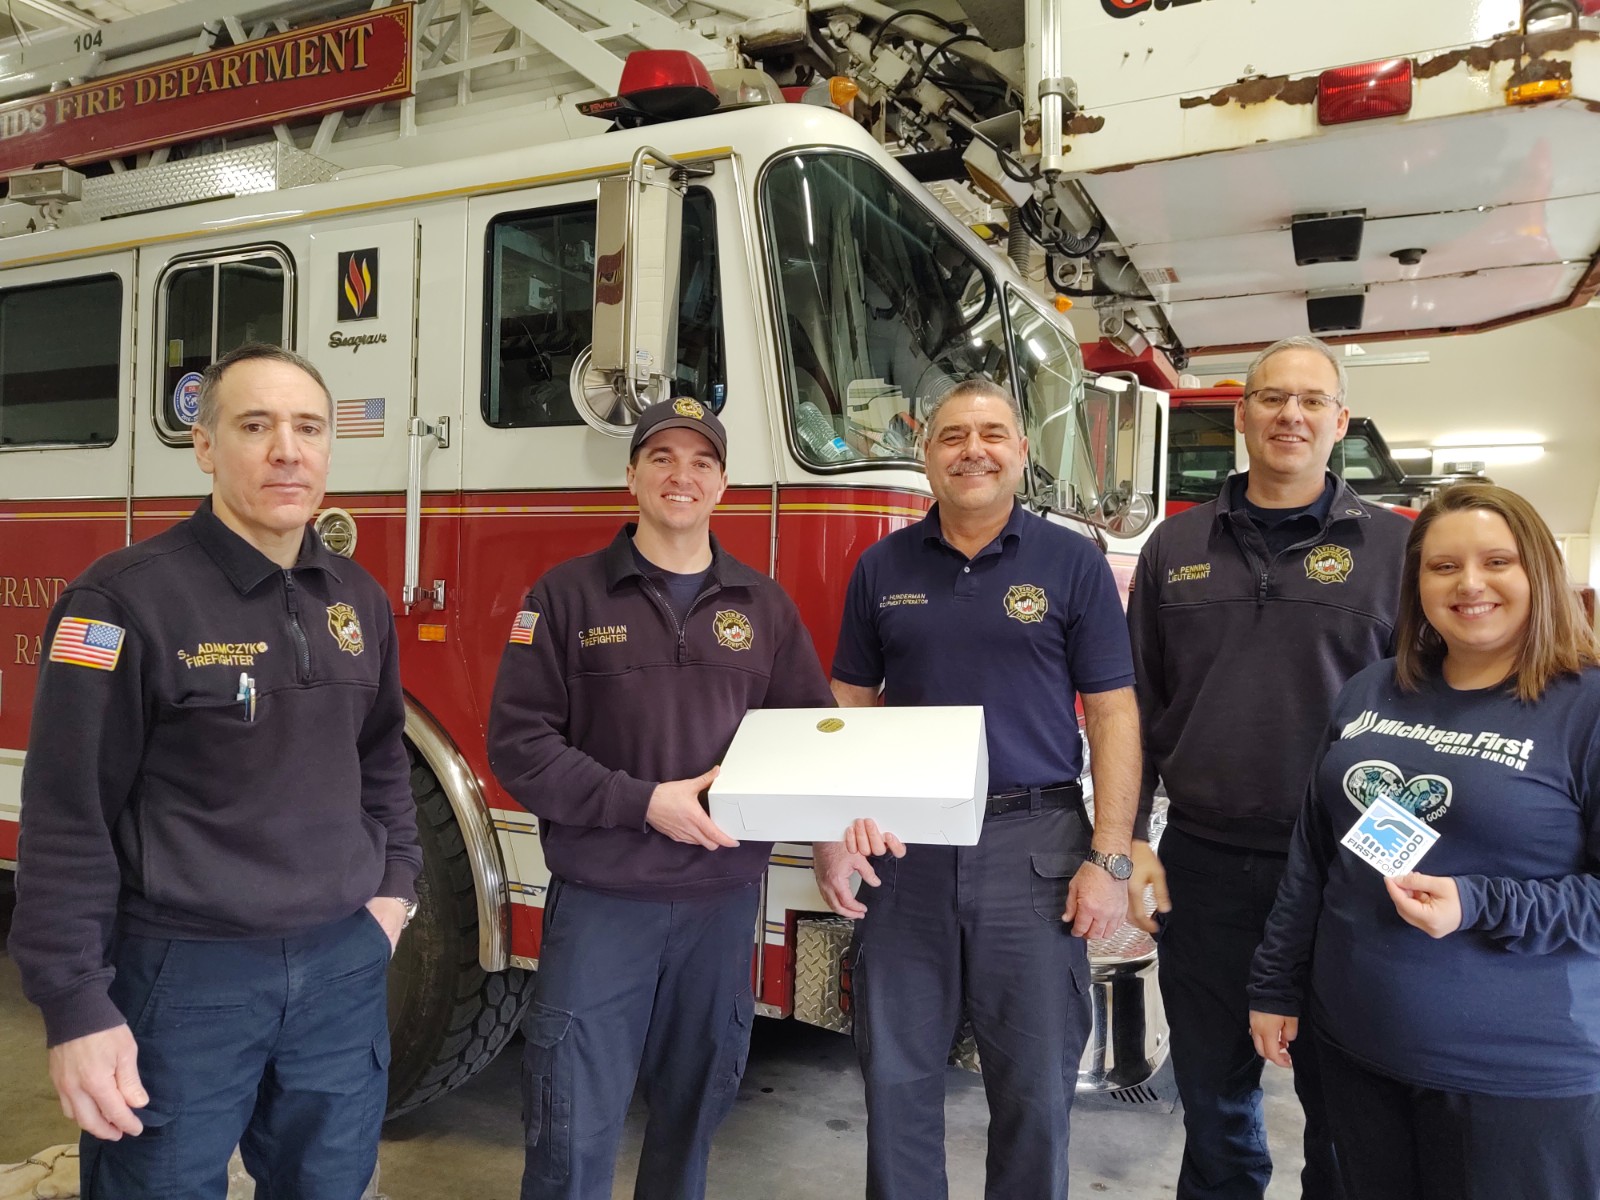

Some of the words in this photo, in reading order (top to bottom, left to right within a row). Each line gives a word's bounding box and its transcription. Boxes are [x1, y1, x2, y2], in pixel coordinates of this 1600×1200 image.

[74, 30, 103, 53] 104
[55, 84, 125, 124] FIRE
[133, 23, 374, 106] DEPARTMENT
[328, 331, 387, 354] Seagrave
[1168, 570, 1211, 583] LIEUTENANT
[1180, 562, 1211, 574] PENNING
[0, 576, 68, 608] RAND
[588, 624, 627, 637] SULLIVAN
[198, 642, 258, 655] ADAMCZYK
[185, 653, 254, 669] FIREFIGHTER
[1371, 718, 1473, 745] Michigan
[1472, 731, 1534, 760] First
[1434, 743, 1480, 758] CREDIT
[1480, 750, 1527, 771] UNION
[1426, 805, 1447, 822] GOOD
[1347, 837, 1377, 860] FIRST
[1375, 858, 1396, 876] FOR
[1392, 834, 1424, 869] GOOD
